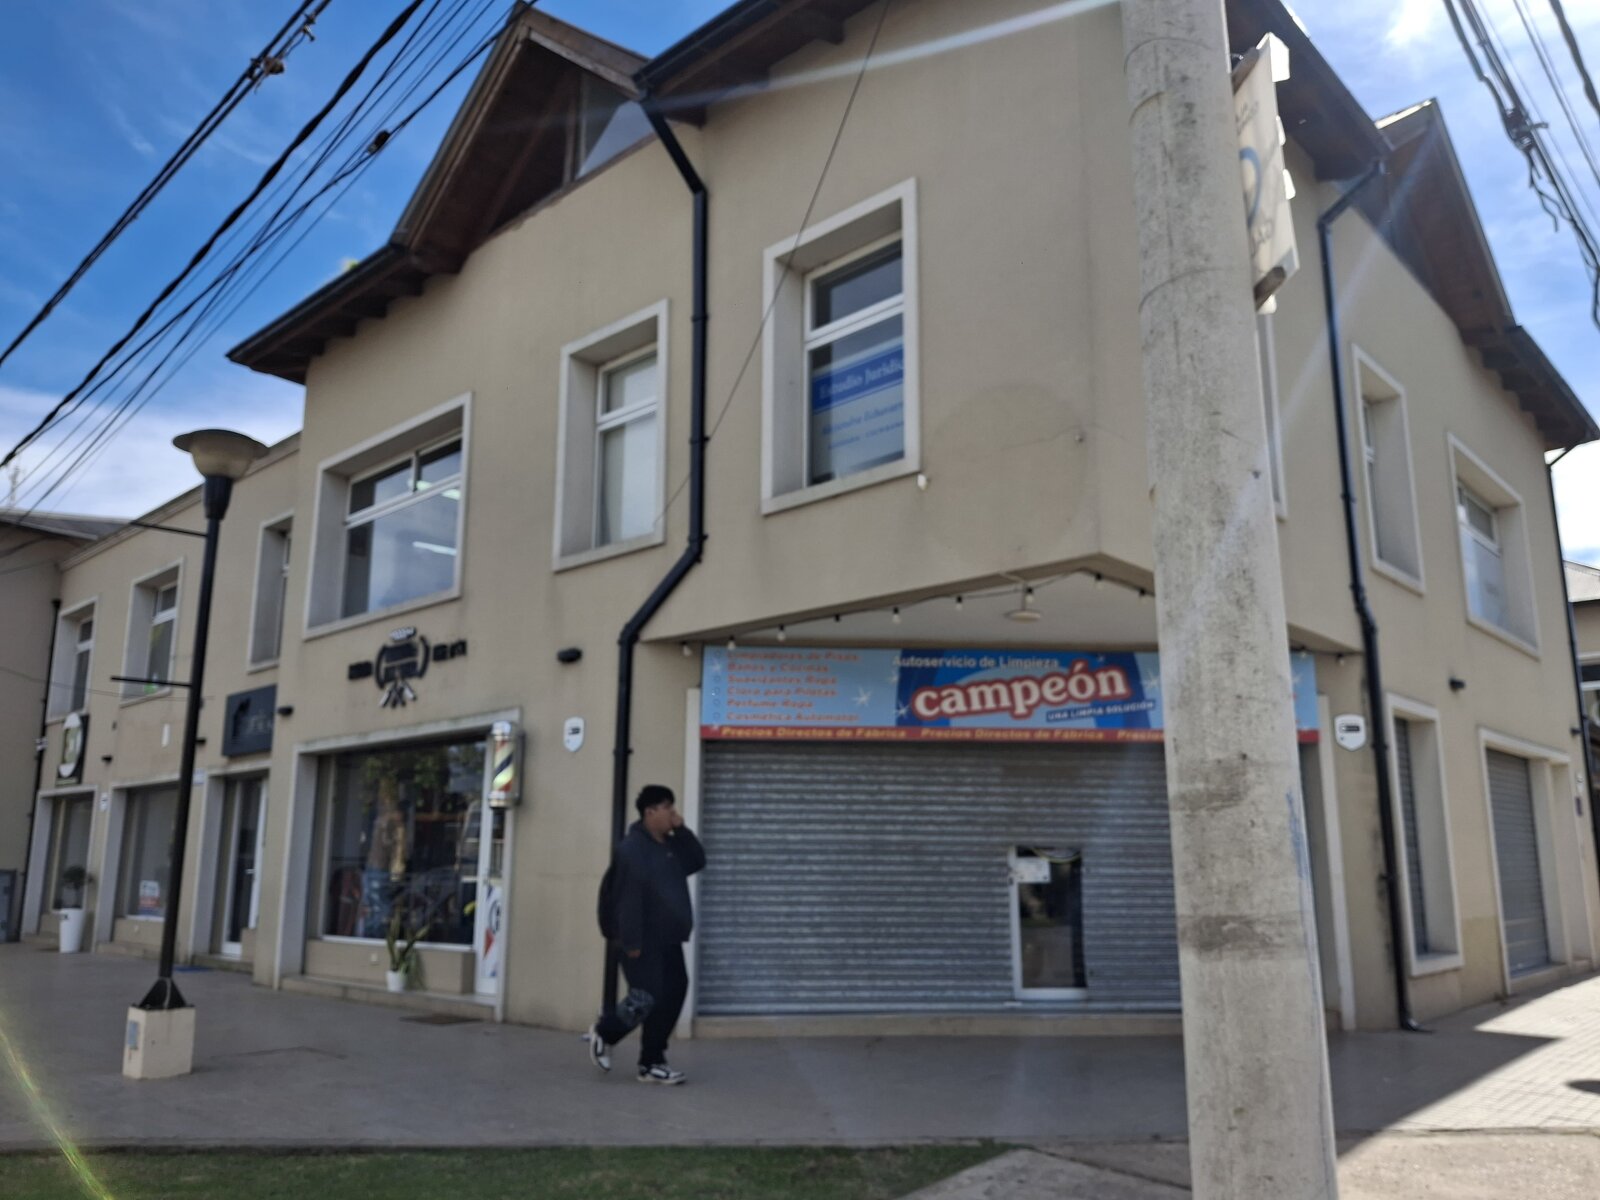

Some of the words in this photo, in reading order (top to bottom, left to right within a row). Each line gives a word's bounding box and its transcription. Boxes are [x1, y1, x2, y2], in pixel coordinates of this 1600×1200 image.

[893, 655, 976, 668] Autoservicio
[979, 656, 995, 668] de
[1000, 656, 1058, 670] Limpieza
[912, 659, 1129, 717] campeón
[721, 726, 773, 737] Precios
[776, 726, 833, 738] Directos
[836, 727, 853, 738] de
[920, 727, 971, 738] Precios
[974, 728, 1031, 739] Directos
[1034, 728, 1050, 739] de
